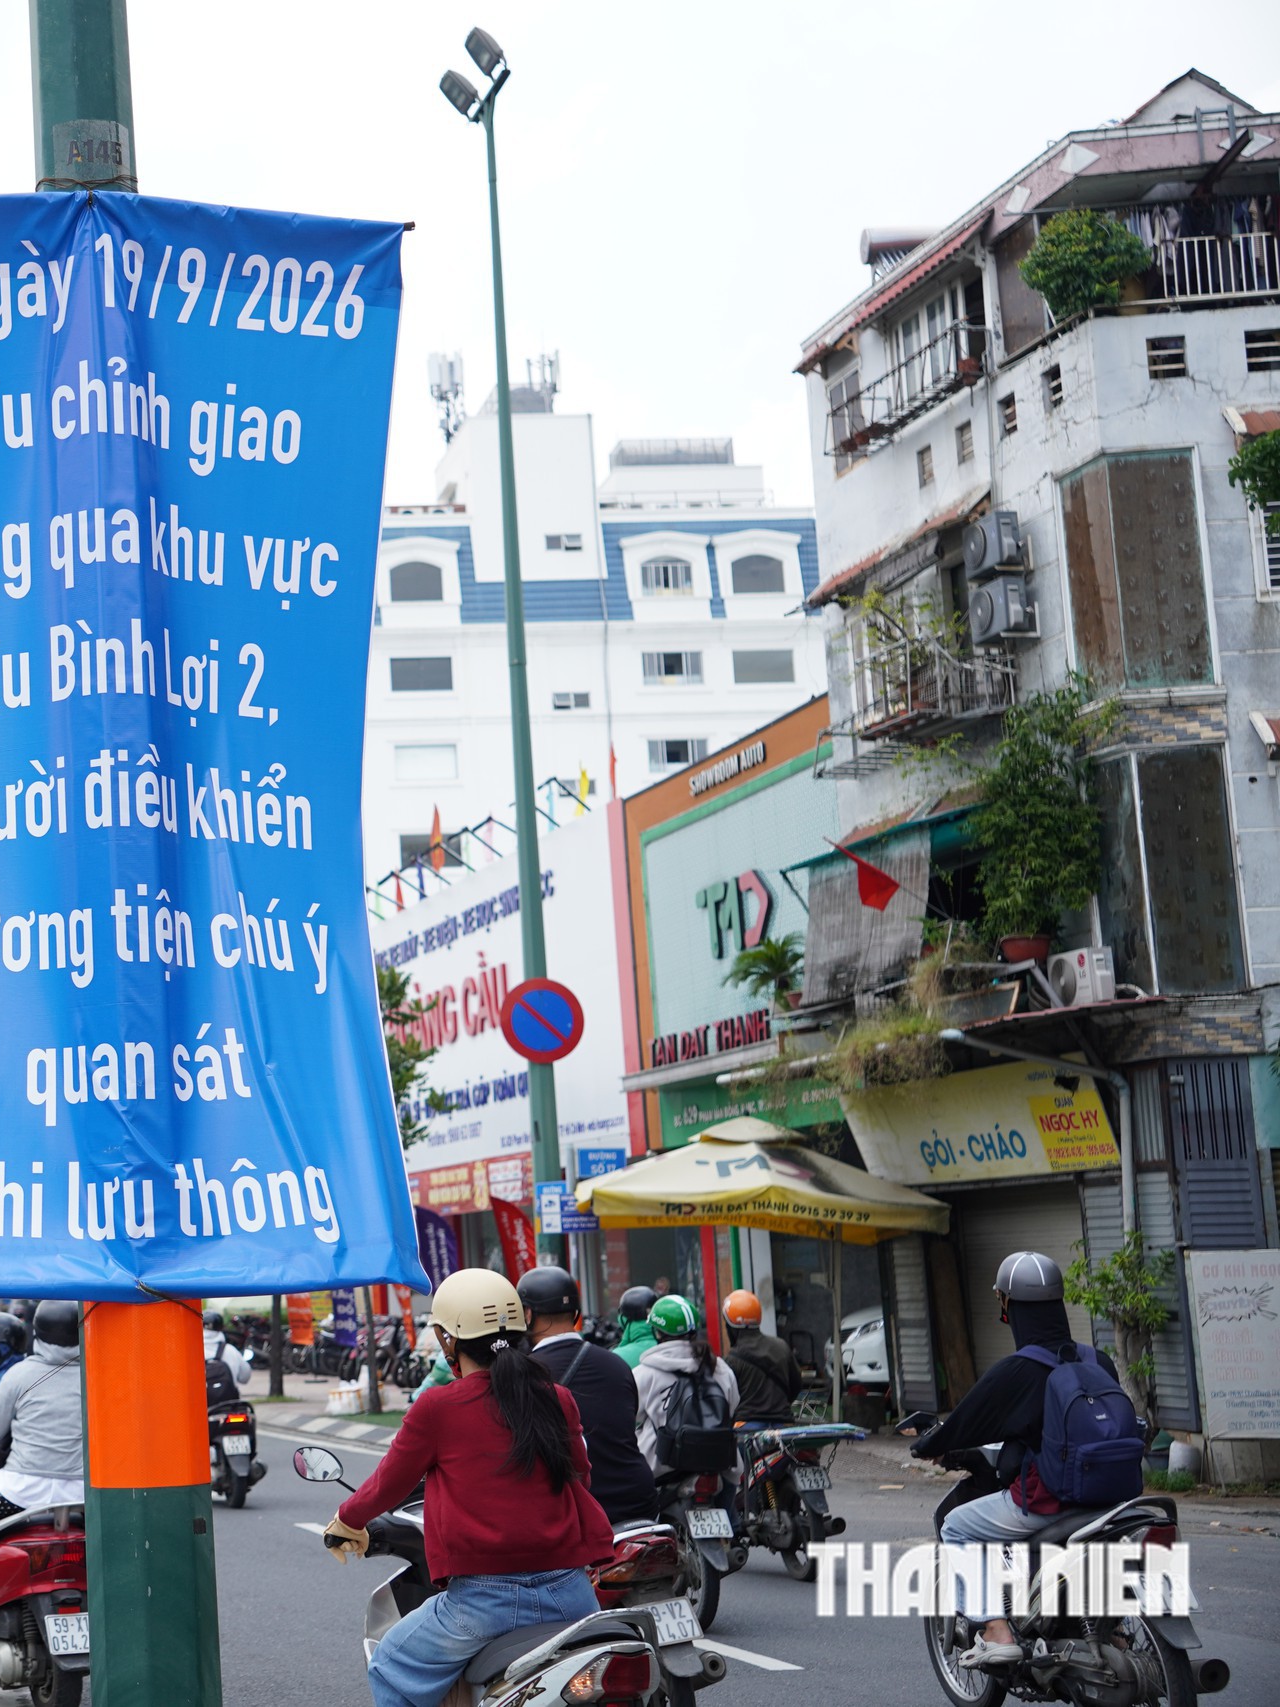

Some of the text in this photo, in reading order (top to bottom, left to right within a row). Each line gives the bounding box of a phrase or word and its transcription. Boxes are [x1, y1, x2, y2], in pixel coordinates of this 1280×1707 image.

[66, 139, 123, 166] A145
[94, 232, 365, 340] 19/9/2026
[51, 356, 170, 450] chỉnh
[189, 383, 302, 477] giao
[49, 507, 140, 589] qua
[149, 496, 225, 586] khu
[243, 535, 339, 611] vực
[49, 618, 156, 703] Bình
[164, 628, 219, 727] Lợi
[238, 643, 279, 726] 2,
[84, 743, 178, 834] điều
[186, 762, 313, 850] khiển
[689, 740, 766, 796] SHOWROOM AUTO
[110, 883, 196, 982] tiện
[210, 891, 295, 972] chú
[302, 902, 328, 995] ý
[463, 950, 508, 1037] CẦU
[26, 1022, 252, 1127] quan sát
[919, 1129, 957, 1168] GỎI
[967, 1123, 1027, 1163] CHÁO
[1039, 1109, 1100, 1136] NGỌC HY
[67, 1161, 156, 1242] lưu
[174, 1157, 340, 1244] thông
[793, 1204, 820, 1217] 0915
[823, 1208, 837, 1219] 39
[839, 1209, 854, 1221] 39
[856, 1212, 871, 1223] 39
[650, 1312, 667, 1327] Grab
[691, 1523, 730, 1537] 262.29
[51, 1634, 89, 1652] 054.2
[646, 1601, 687, 1622] 9-V2
